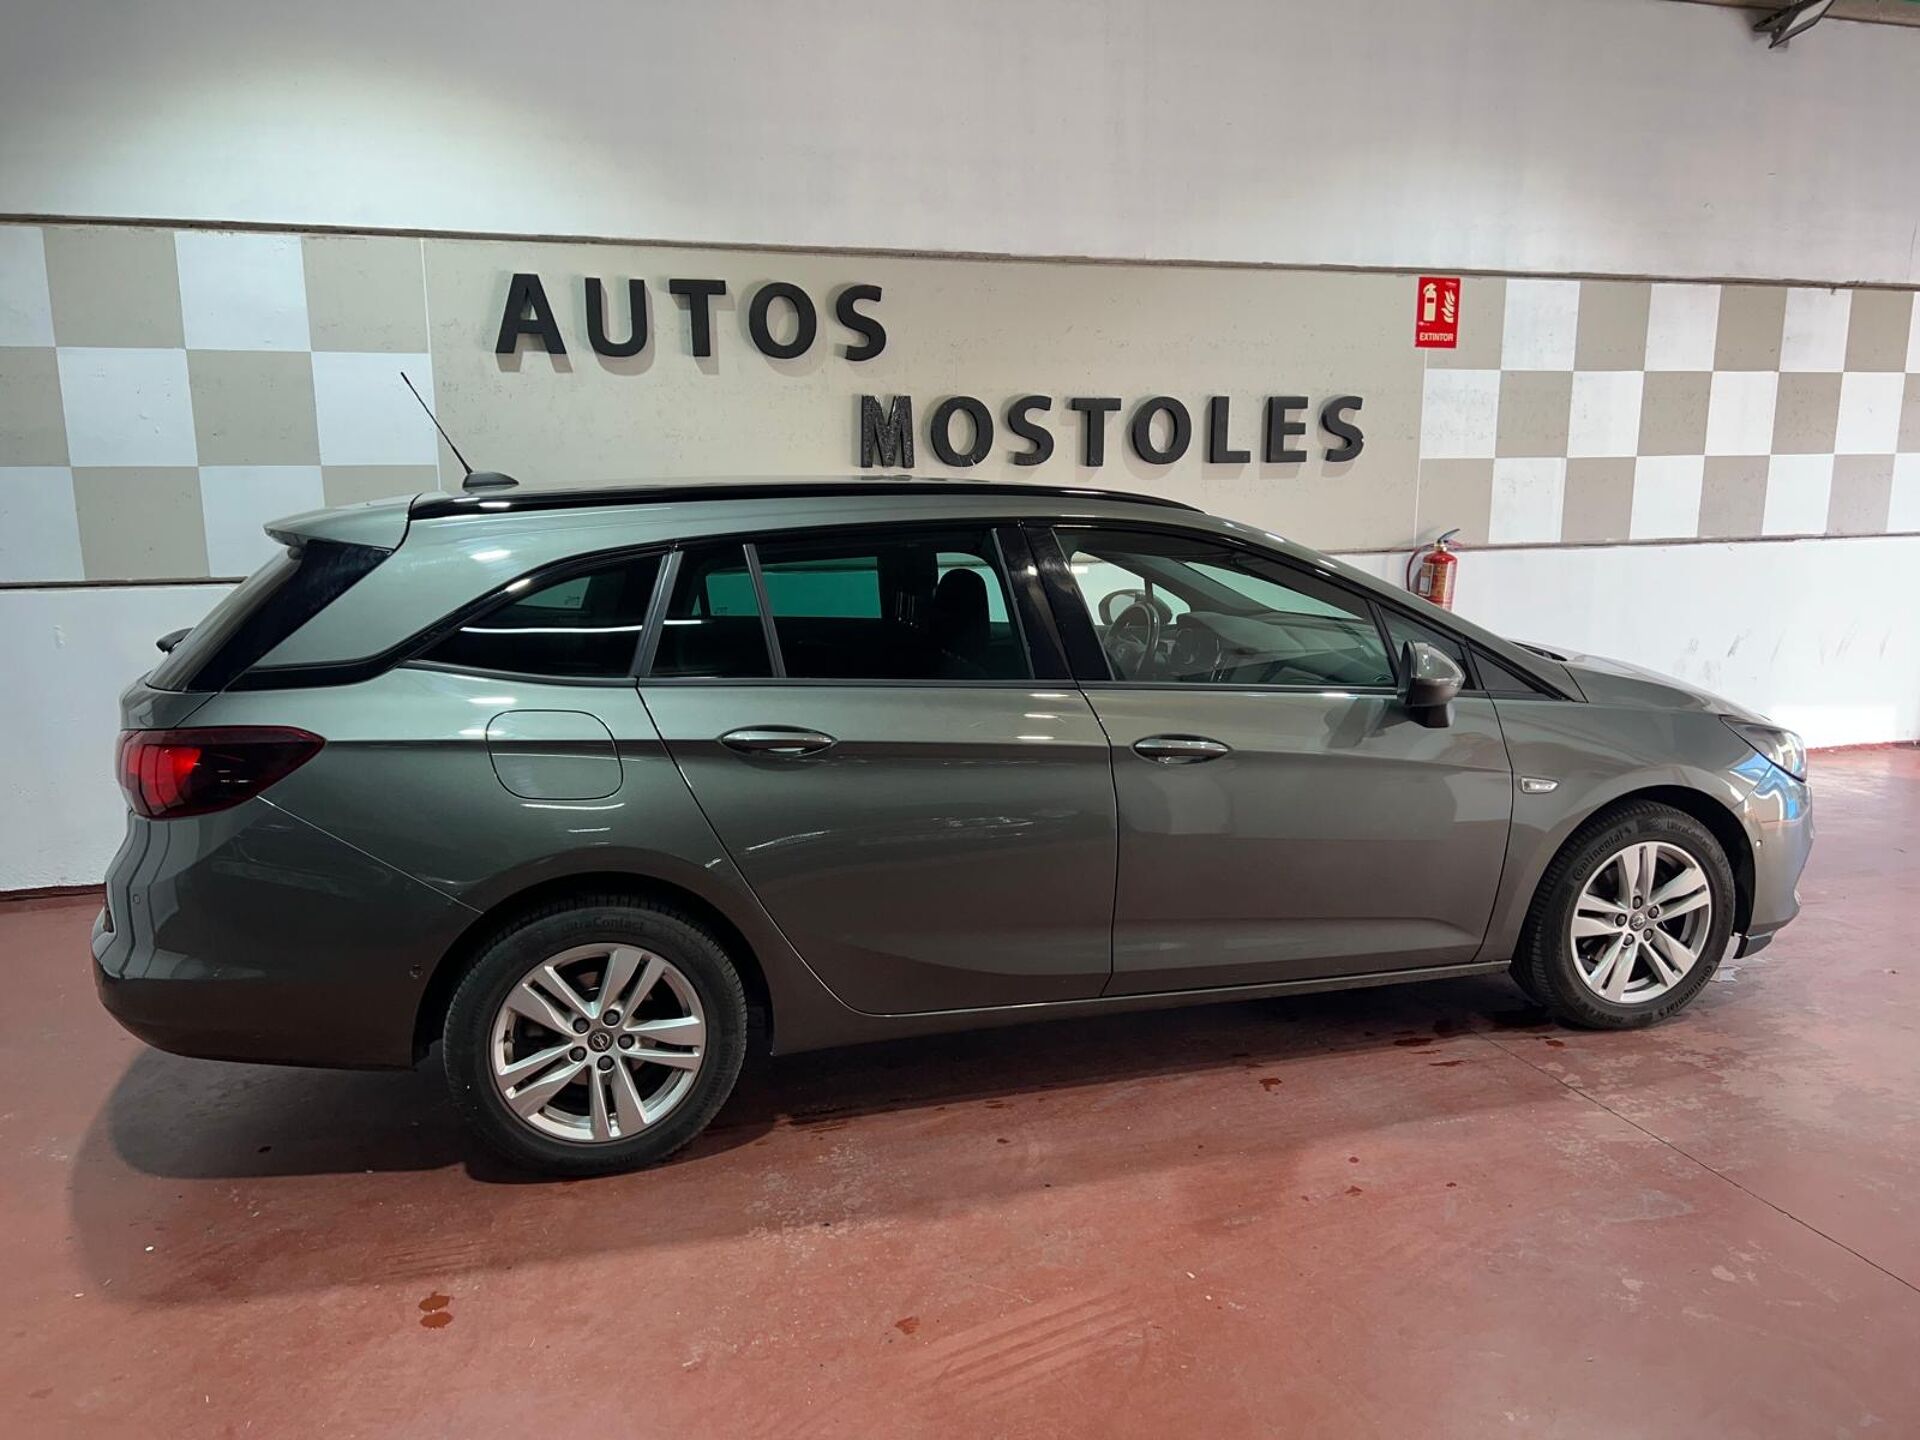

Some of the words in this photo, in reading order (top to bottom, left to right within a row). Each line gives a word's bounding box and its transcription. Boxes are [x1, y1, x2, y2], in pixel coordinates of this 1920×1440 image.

[496, 274, 886, 361] AUTOS
[1419, 332, 1454, 342] EXTINTOR
[861, 395, 1365, 468] MOSTOLES
